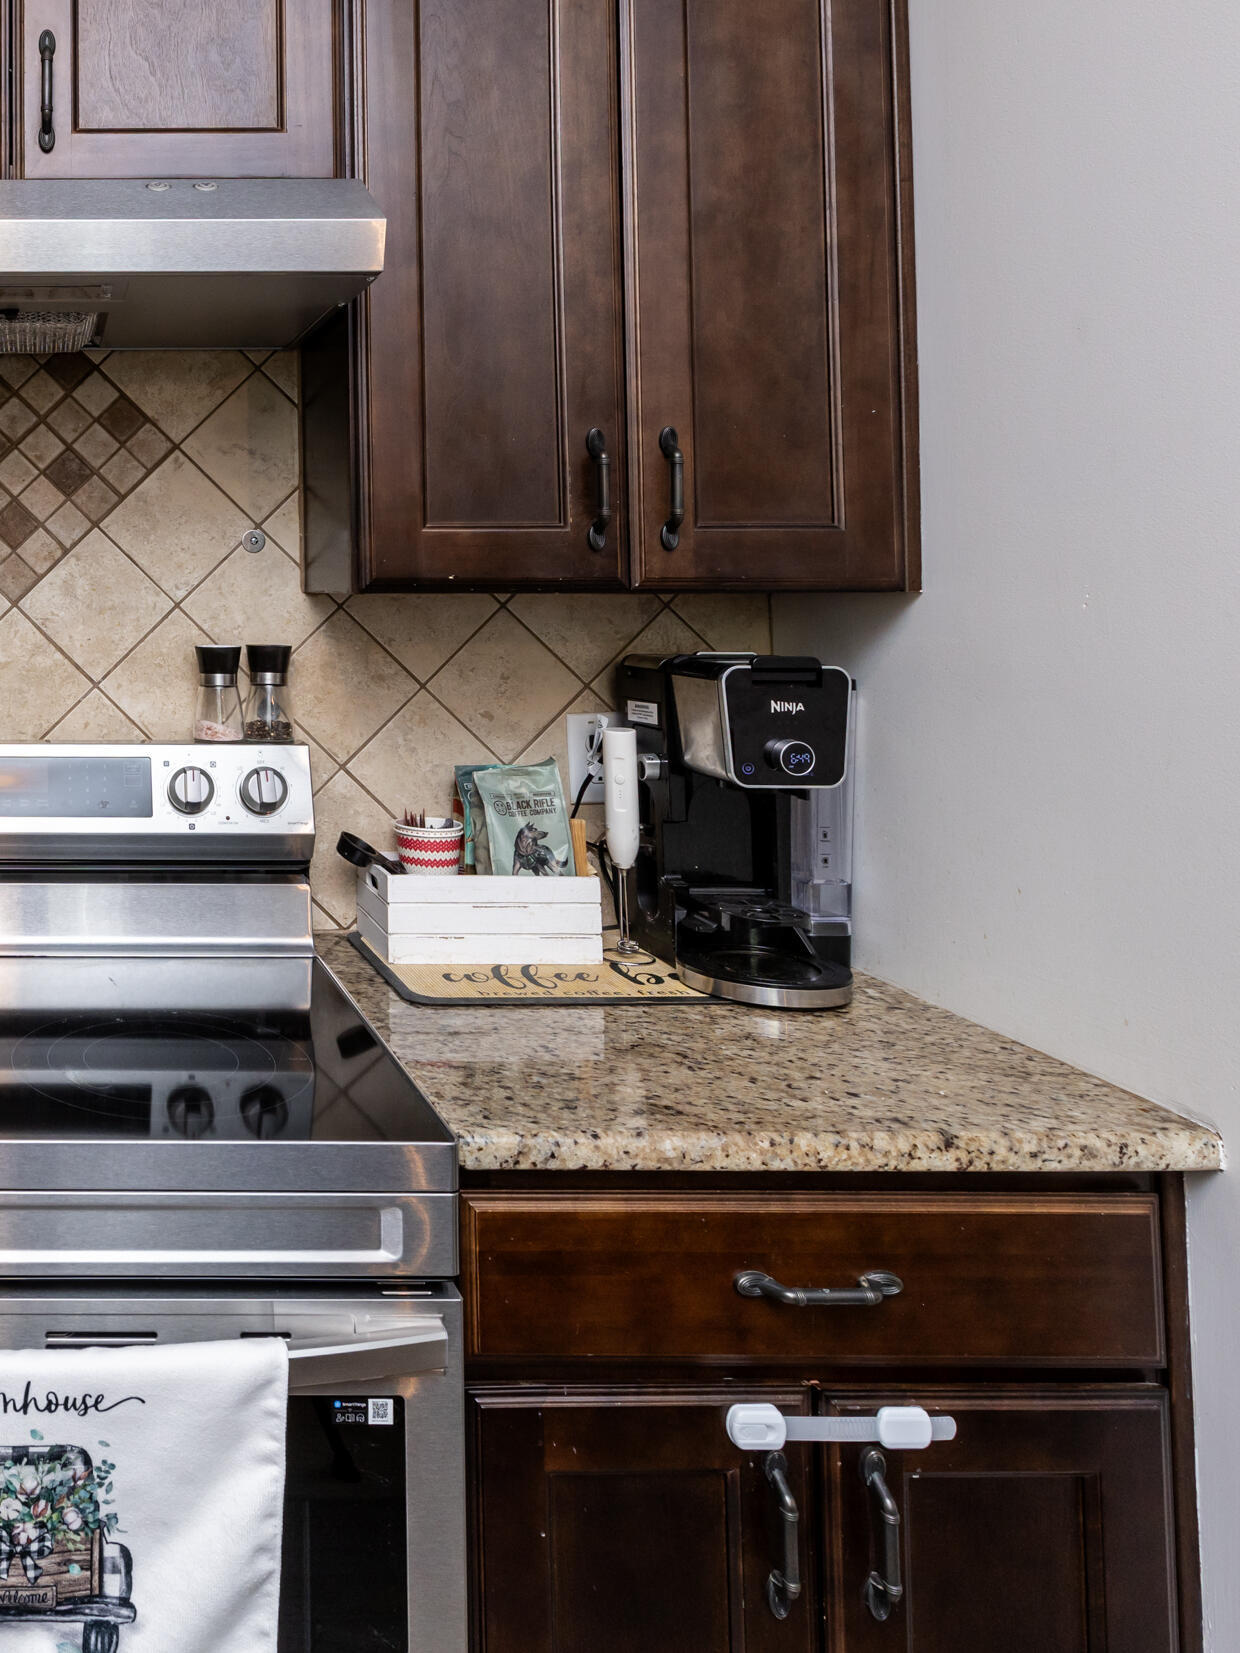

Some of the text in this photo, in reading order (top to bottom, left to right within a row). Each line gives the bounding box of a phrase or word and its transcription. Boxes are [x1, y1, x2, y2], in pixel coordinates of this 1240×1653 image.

[770, 699, 805, 715] NINJA
[790, 753, 811, 764] 6:49
[506, 799, 532, 811] BLACK
[533, 798, 556, 808] RIFLE
[508, 807, 557, 817] COFFEE COMPANY
[442, 964, 599, 990] coffee
